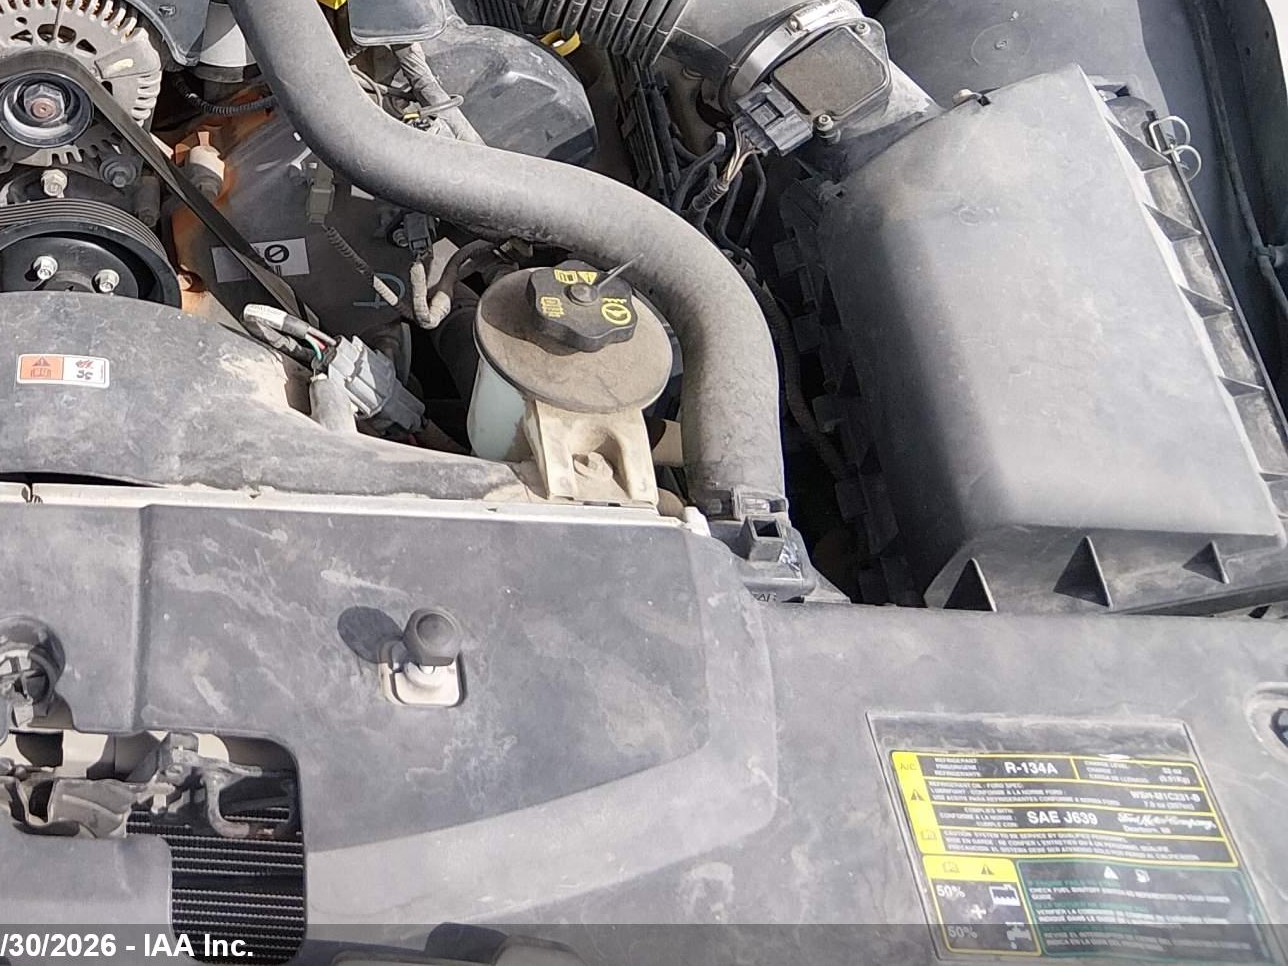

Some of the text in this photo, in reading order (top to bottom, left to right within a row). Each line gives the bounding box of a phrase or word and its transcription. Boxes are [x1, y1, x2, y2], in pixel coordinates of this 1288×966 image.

[1003, 761, 1059, 775] R-134A
[1026, 810, 1099, 826] SAE J639
[937, 885, 966, 899] 50%
[948, 924, 978, 939] 50%
